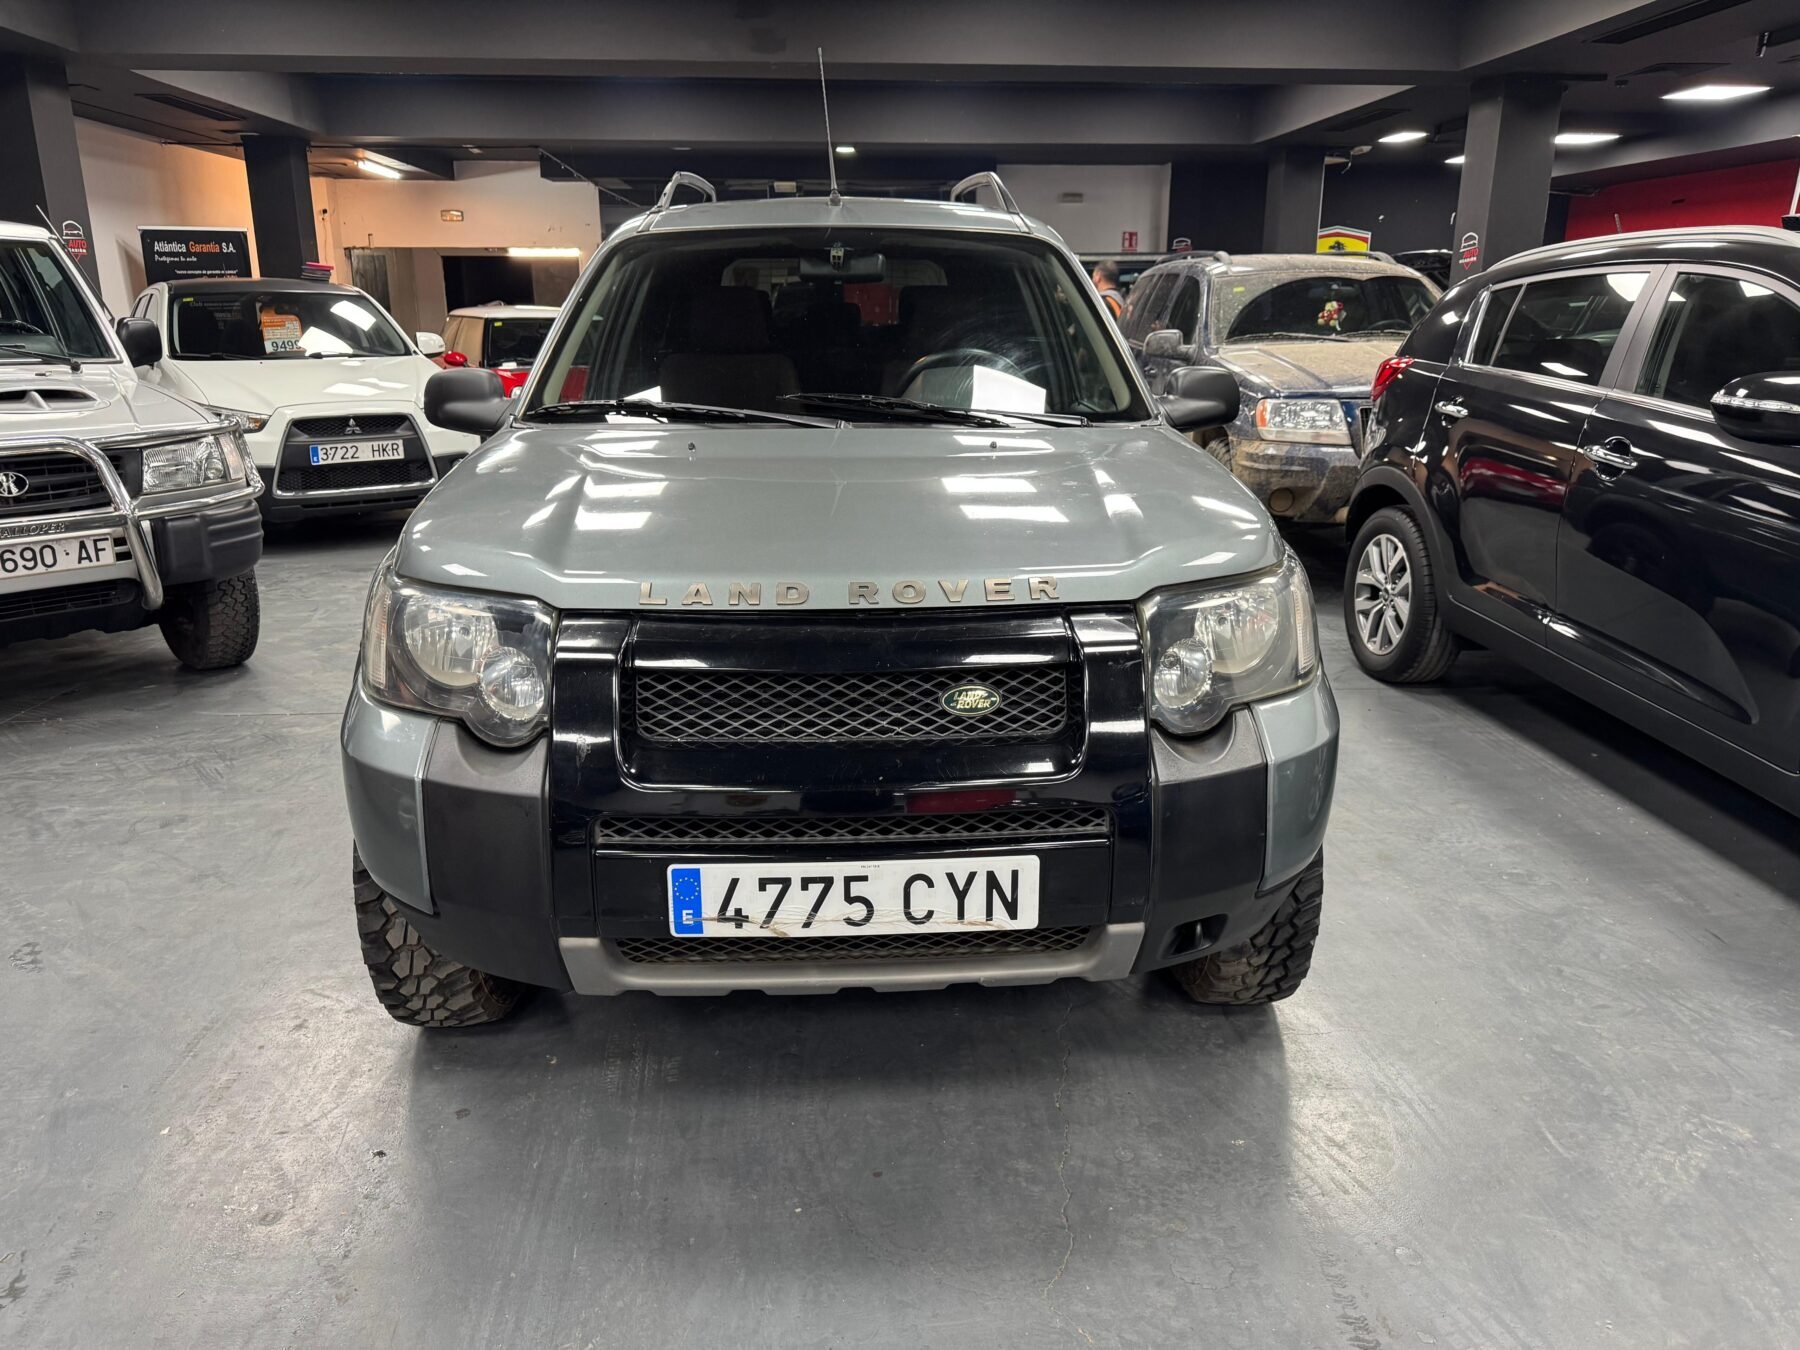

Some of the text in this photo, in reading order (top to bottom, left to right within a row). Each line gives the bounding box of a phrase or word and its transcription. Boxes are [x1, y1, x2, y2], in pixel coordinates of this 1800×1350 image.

[68, 239, 87, 249] AUTO
[154, 240, 237, 253] Atlántica Garantía S.A.
[320, 442, 400, 461] 3722 HKR
[0, 522, 65, 538] ALLOPER
[0, 537, 110, 573] 690 AF
[638, 575, 1060, 606] LAND ROVER
[953, 690, 983, 700] LAND
[956, 699, 991, 709] ROVER
[716, 869, 1019, 929] 4775 CYN
[682, 910, 694, 924] E
